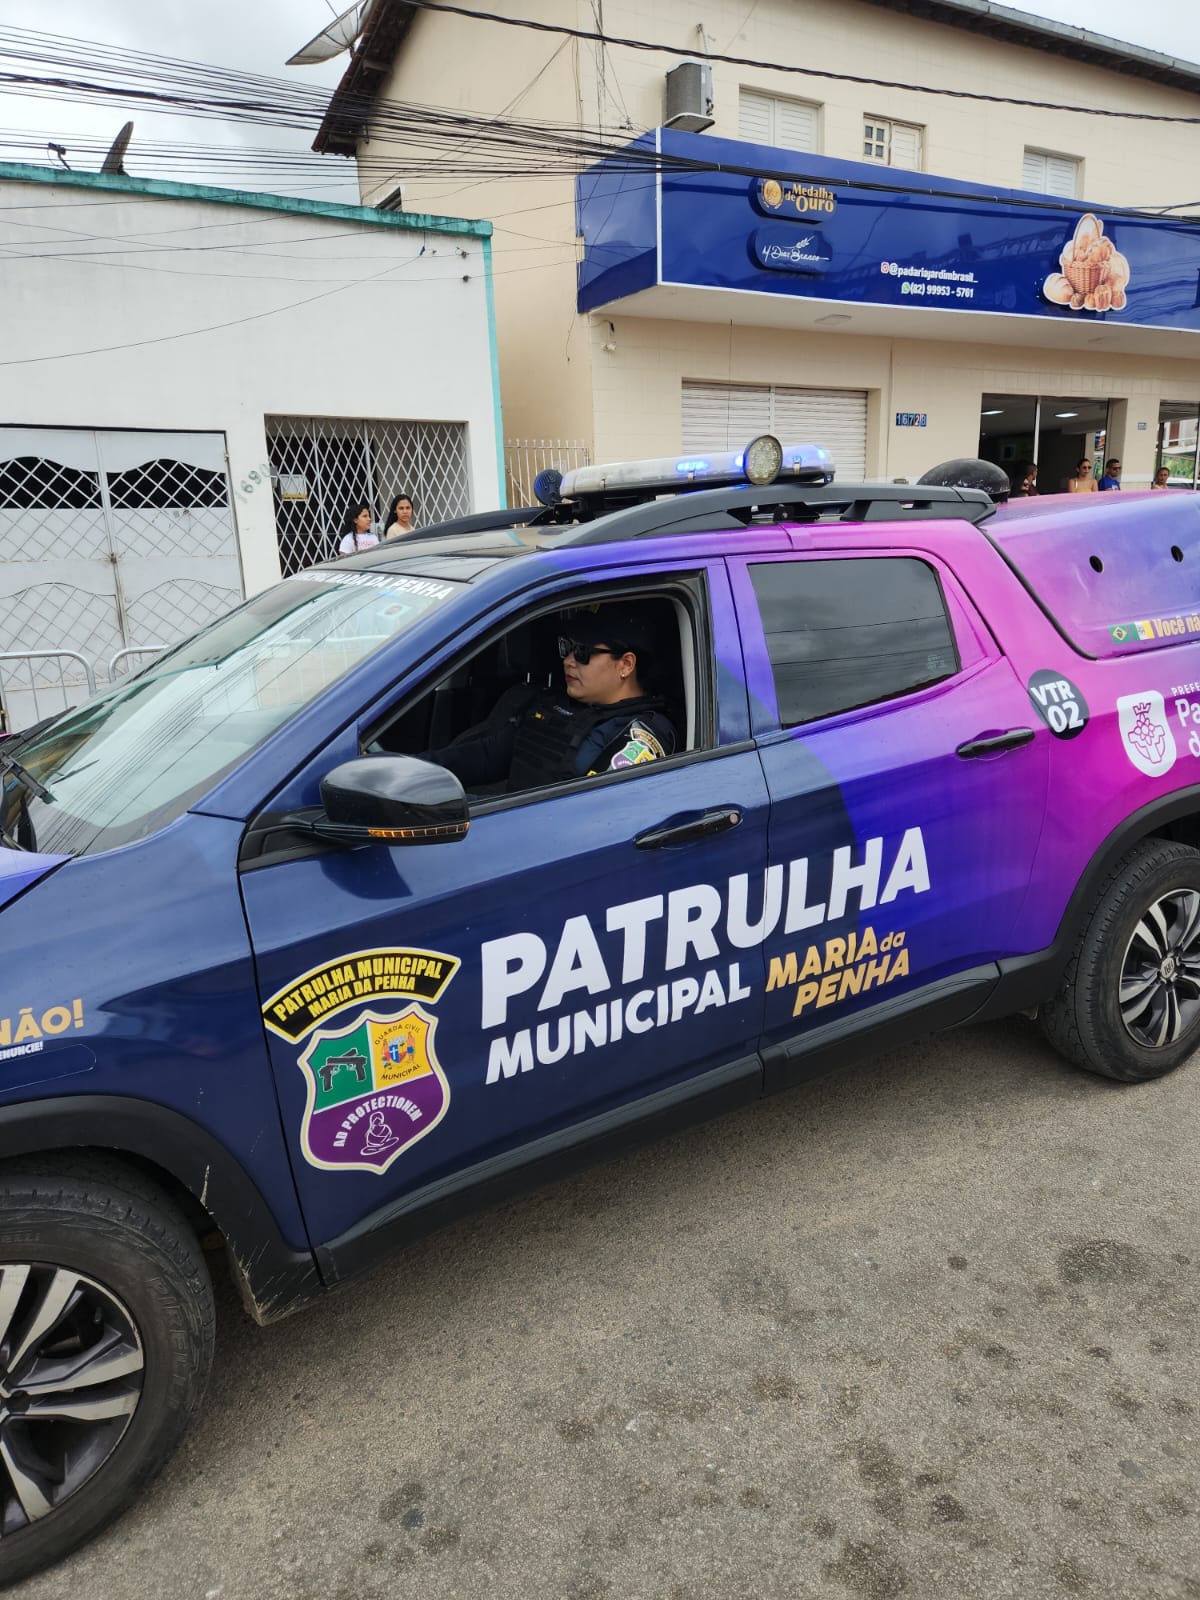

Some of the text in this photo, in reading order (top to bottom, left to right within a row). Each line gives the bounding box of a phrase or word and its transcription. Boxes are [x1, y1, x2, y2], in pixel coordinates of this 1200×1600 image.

[784, 190, 835, 213] de Ouro
[791, 183, 835, 201] Medalha
[910, 282, 926, 296] (82)
[926, 284, 951, 297] 99953
[390, 578, 455, 600] PENHA
[1152, 614, 1186, 638] Você
[1031, 680, 1076, 706] VTR
[1047, 702, 1084, 734] 02
[479, 826, 931, 1030] PATRULHA
[765, 926, 906, 992] MARIA da
[273, 956, 443, 1022] PATRULHA MUNICIPAL
[792, 946, 910, 1018] PENHA
[307, 975, 416, 1018] MARIA DA PENHA
[374, 1023, 421, 1045] GUARDA CIVIL
[484, 962, 751, 1086] MUNICIPAL
[380, 1063, 422, 1081] MUNICIPAL
[333, 1131, 349, 1147] AD
